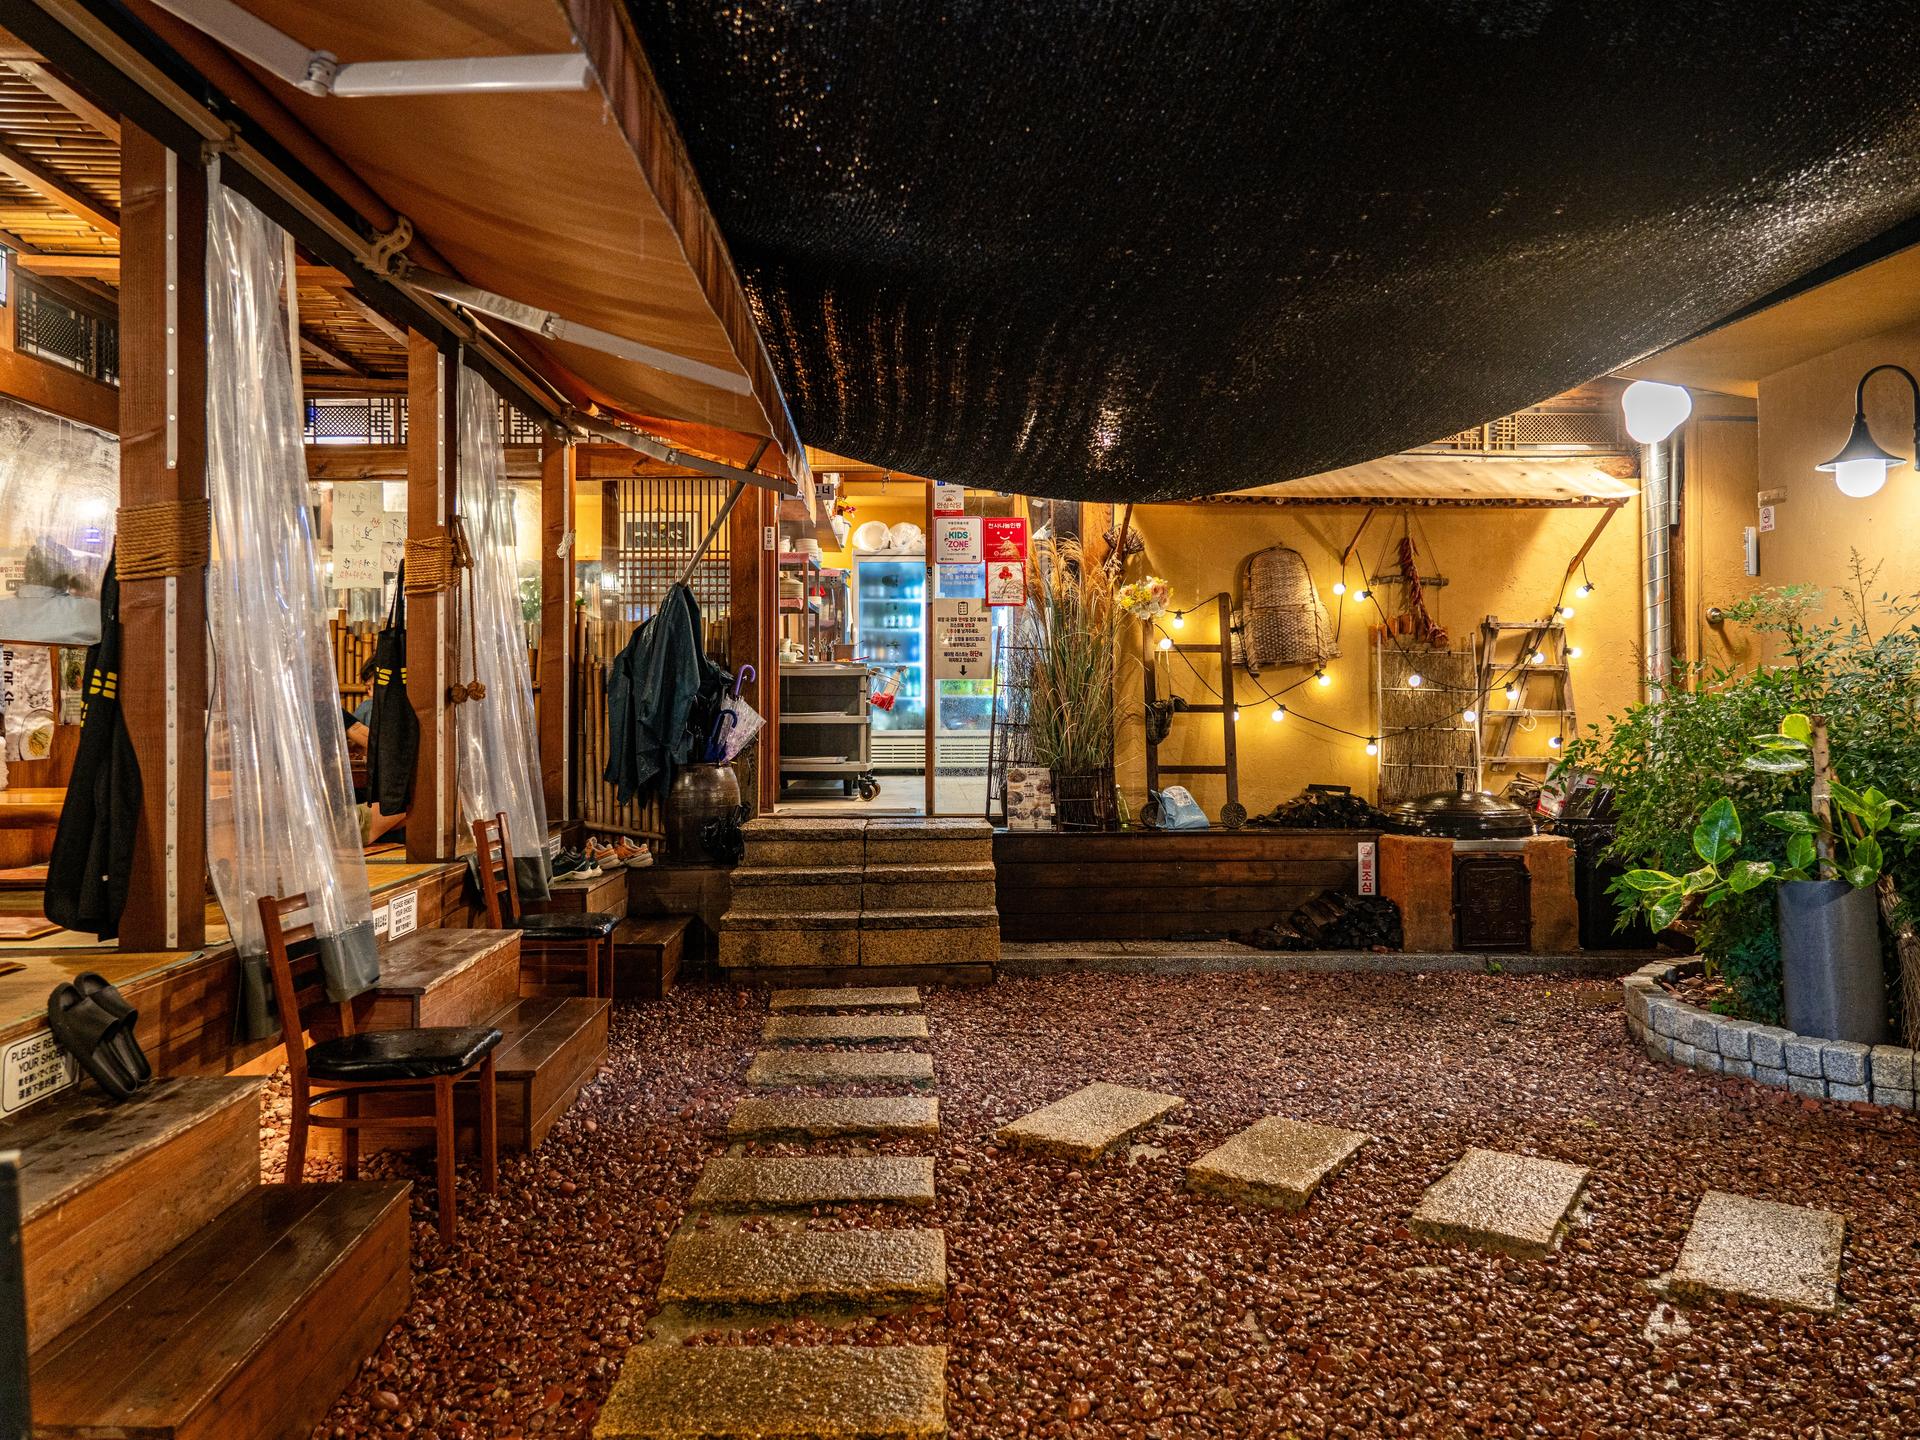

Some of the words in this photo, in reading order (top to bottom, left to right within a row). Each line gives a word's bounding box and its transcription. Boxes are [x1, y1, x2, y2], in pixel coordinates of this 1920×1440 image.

[948, 531, 968, 539] KIDS
[948, 540, 969, 548] ZONE
[1361, 859, 1372, 893] 불조심
[11, 1042, 41, 1063] PLEASE
[18, 1057, 39, 1074] YOUR
